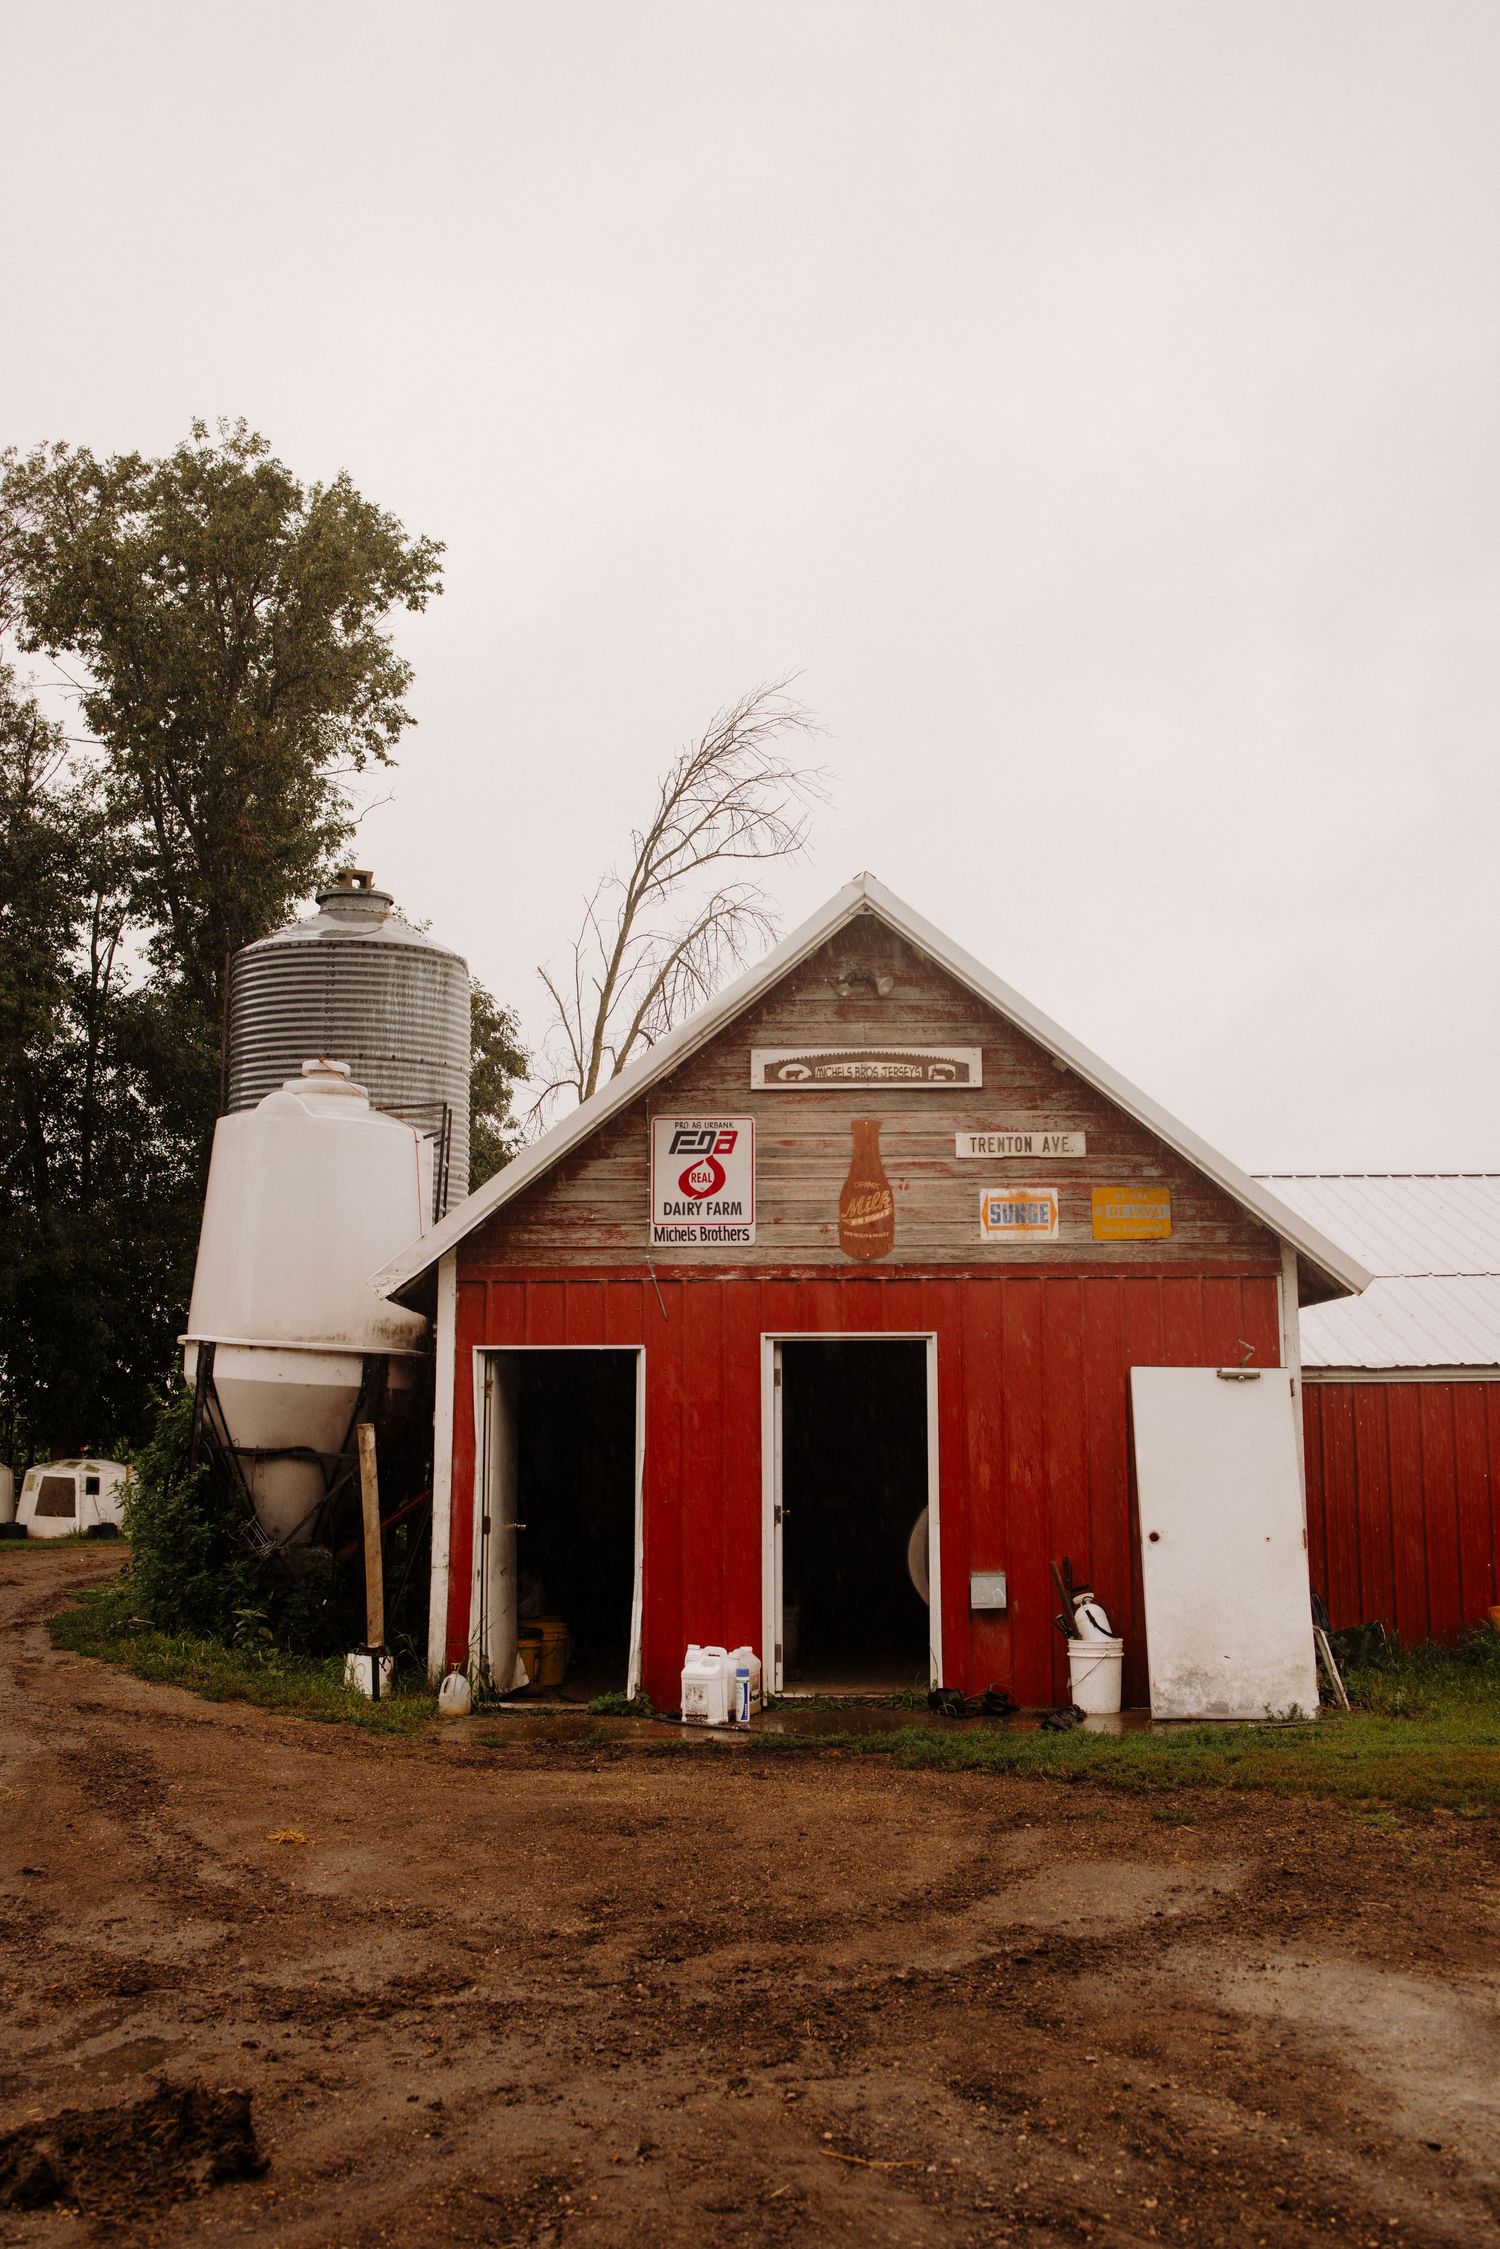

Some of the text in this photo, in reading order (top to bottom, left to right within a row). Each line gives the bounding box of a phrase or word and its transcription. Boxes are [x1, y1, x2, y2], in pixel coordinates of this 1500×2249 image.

[816, 1066, 853, 1078] MICHELS
[880, 1066, 921, 1078] JERSEYS
[969, 1136, 1075, 1153] TRENTON AVE.
[691, 1172, 713, 1183] REAL
[853, 1181, 881, 1190] DRINK
[663, 1201, 743, 1216] DAIRY FARM
[841, 1190, 892, 1217] Milk
[990, 1203, 1049, 1224] SURGE
[654, 1225, 750, 1242] Michels Brothers
